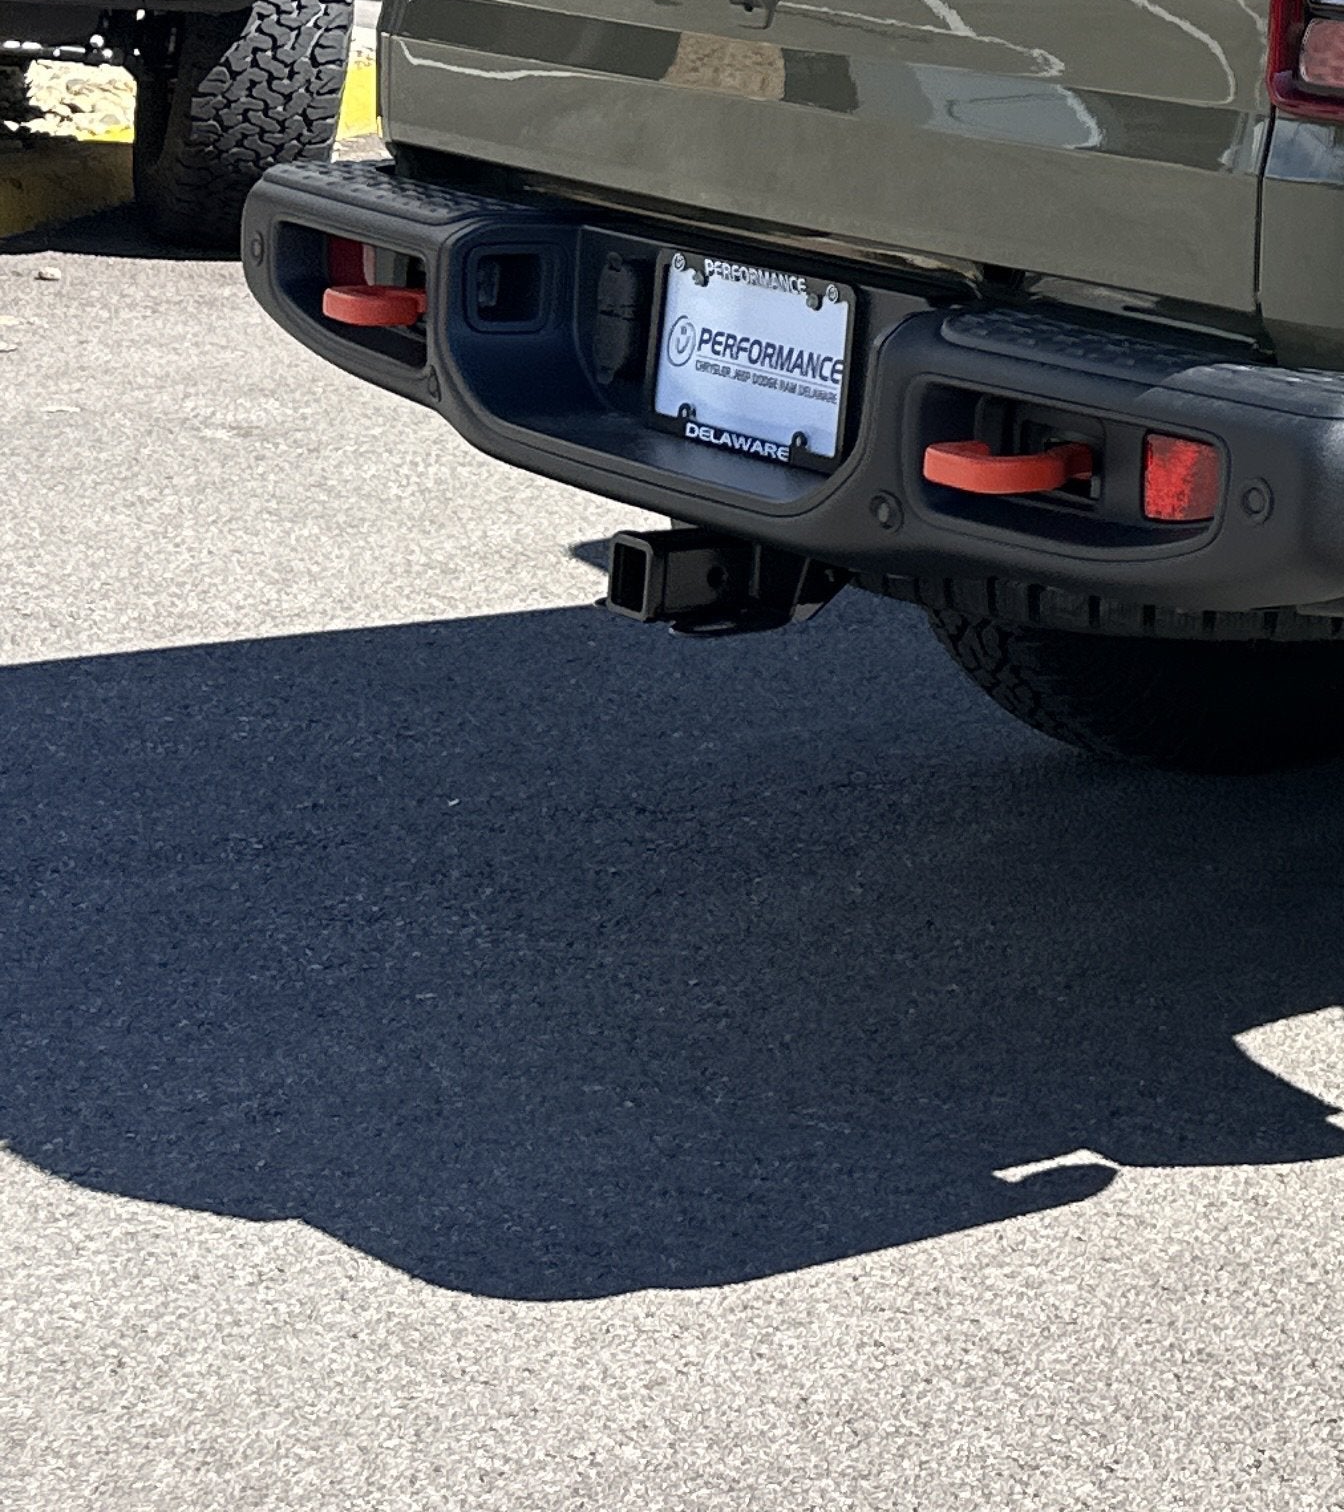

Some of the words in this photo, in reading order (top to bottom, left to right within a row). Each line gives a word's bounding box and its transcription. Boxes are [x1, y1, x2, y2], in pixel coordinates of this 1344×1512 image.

[704, 258, 807, 295] PERFORMANCE
[697, 328, 844, 384] PERFORMANCE
[685, 421, 790, 463] DELAWARE
